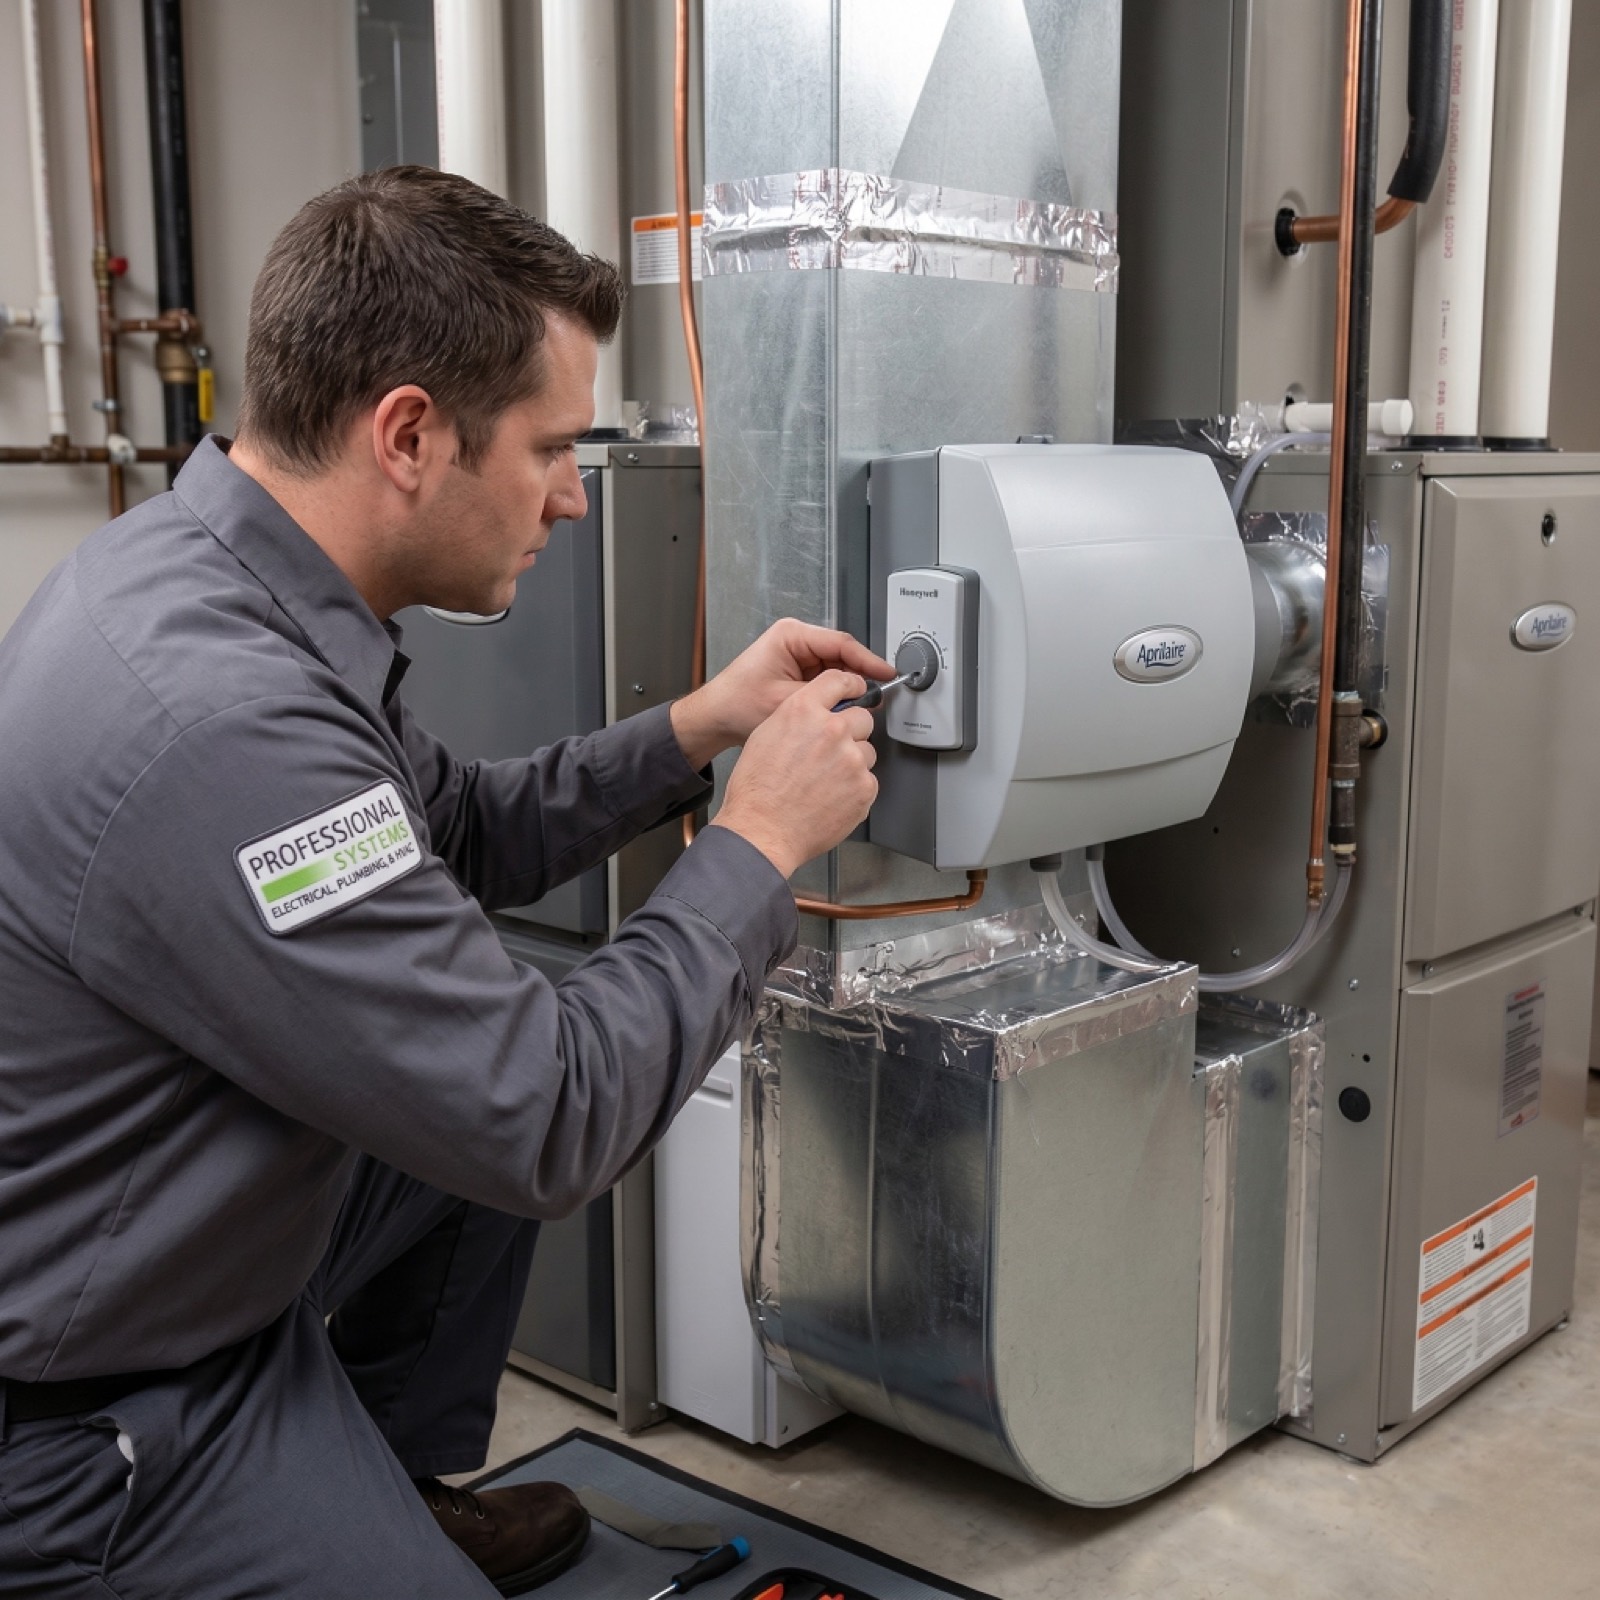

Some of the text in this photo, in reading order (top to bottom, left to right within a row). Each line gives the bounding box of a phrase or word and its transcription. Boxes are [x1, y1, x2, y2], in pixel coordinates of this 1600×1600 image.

[899, 587, 939, 599] Honeywell
[1136, 641, 1185, 669] Aprilaire
[248, 795, 401, 880] PROFESSIONAL
[333, 820, 409, 871] SYSTEMS
[271, 884, 338, 919] ELECTRICAL,
[336, 857, 389, 890] PLUMBING,
